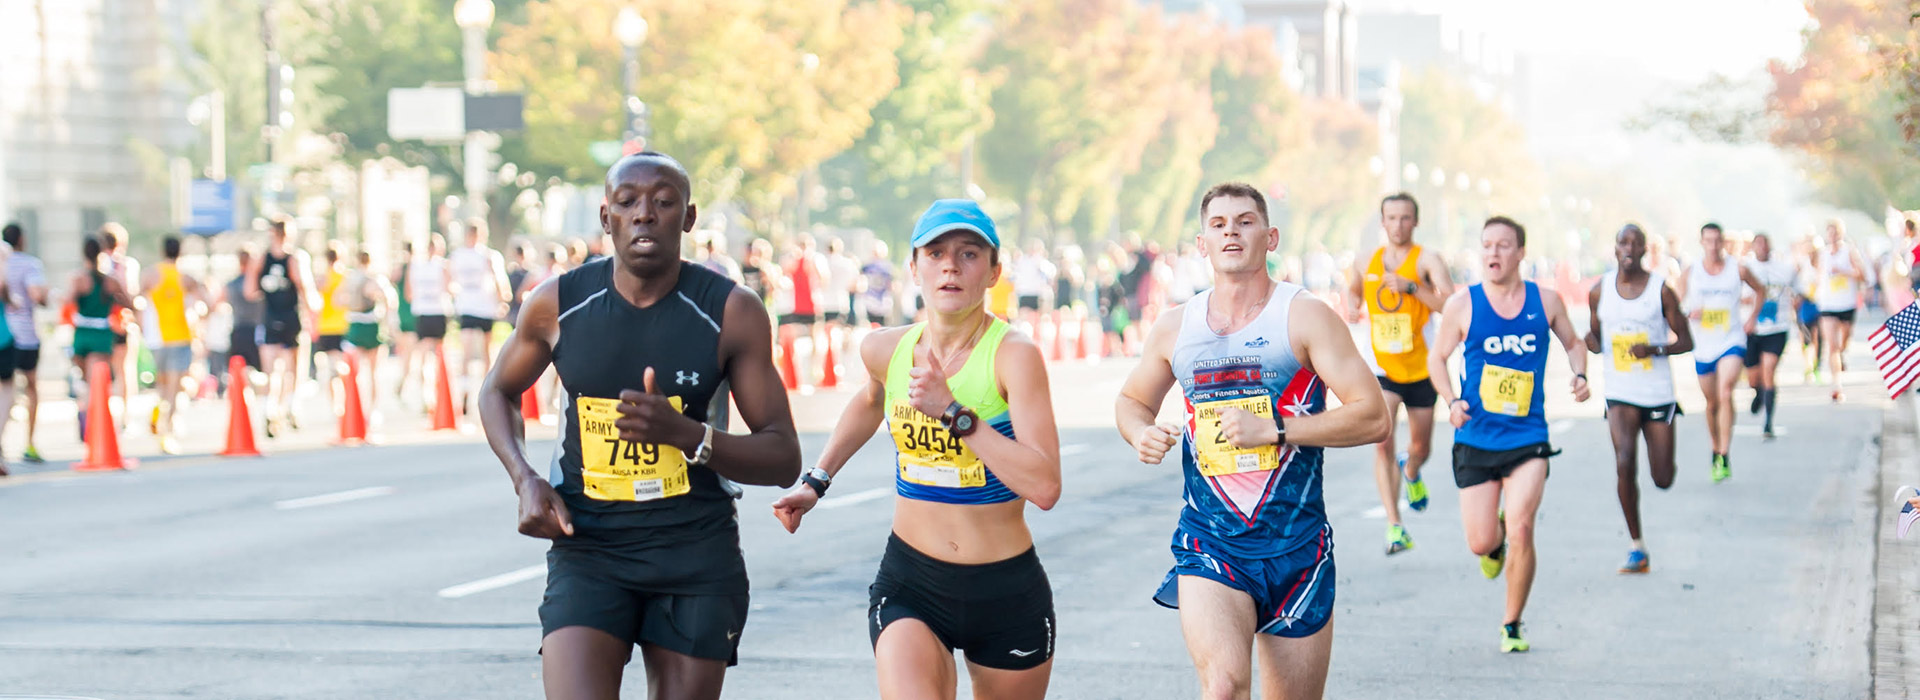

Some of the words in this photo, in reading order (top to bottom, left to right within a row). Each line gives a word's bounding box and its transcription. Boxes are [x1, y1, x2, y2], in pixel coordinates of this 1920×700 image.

[1484, 334, 1536, 355] GRC
[1195, 359, 1218, 368] UNITED
[1219, 356, 1241, 365] STATES
[1242, 355, 1260, 363] ARMY
[1194, 373, 1212, 385] FORT
[1250, 369, 1261, 380] GA
[1192, 392, 1211, 400] Sports
[1214, 389, 1240, 397] Fitness
[1242, 387, 1269, 396] Aquatics
[894, 405, 918, 421] ARMY
[585, 420, 612, 436] ARMY
[902, 422, 963, 456] 3454
[604, 438, 660, 466] 749
